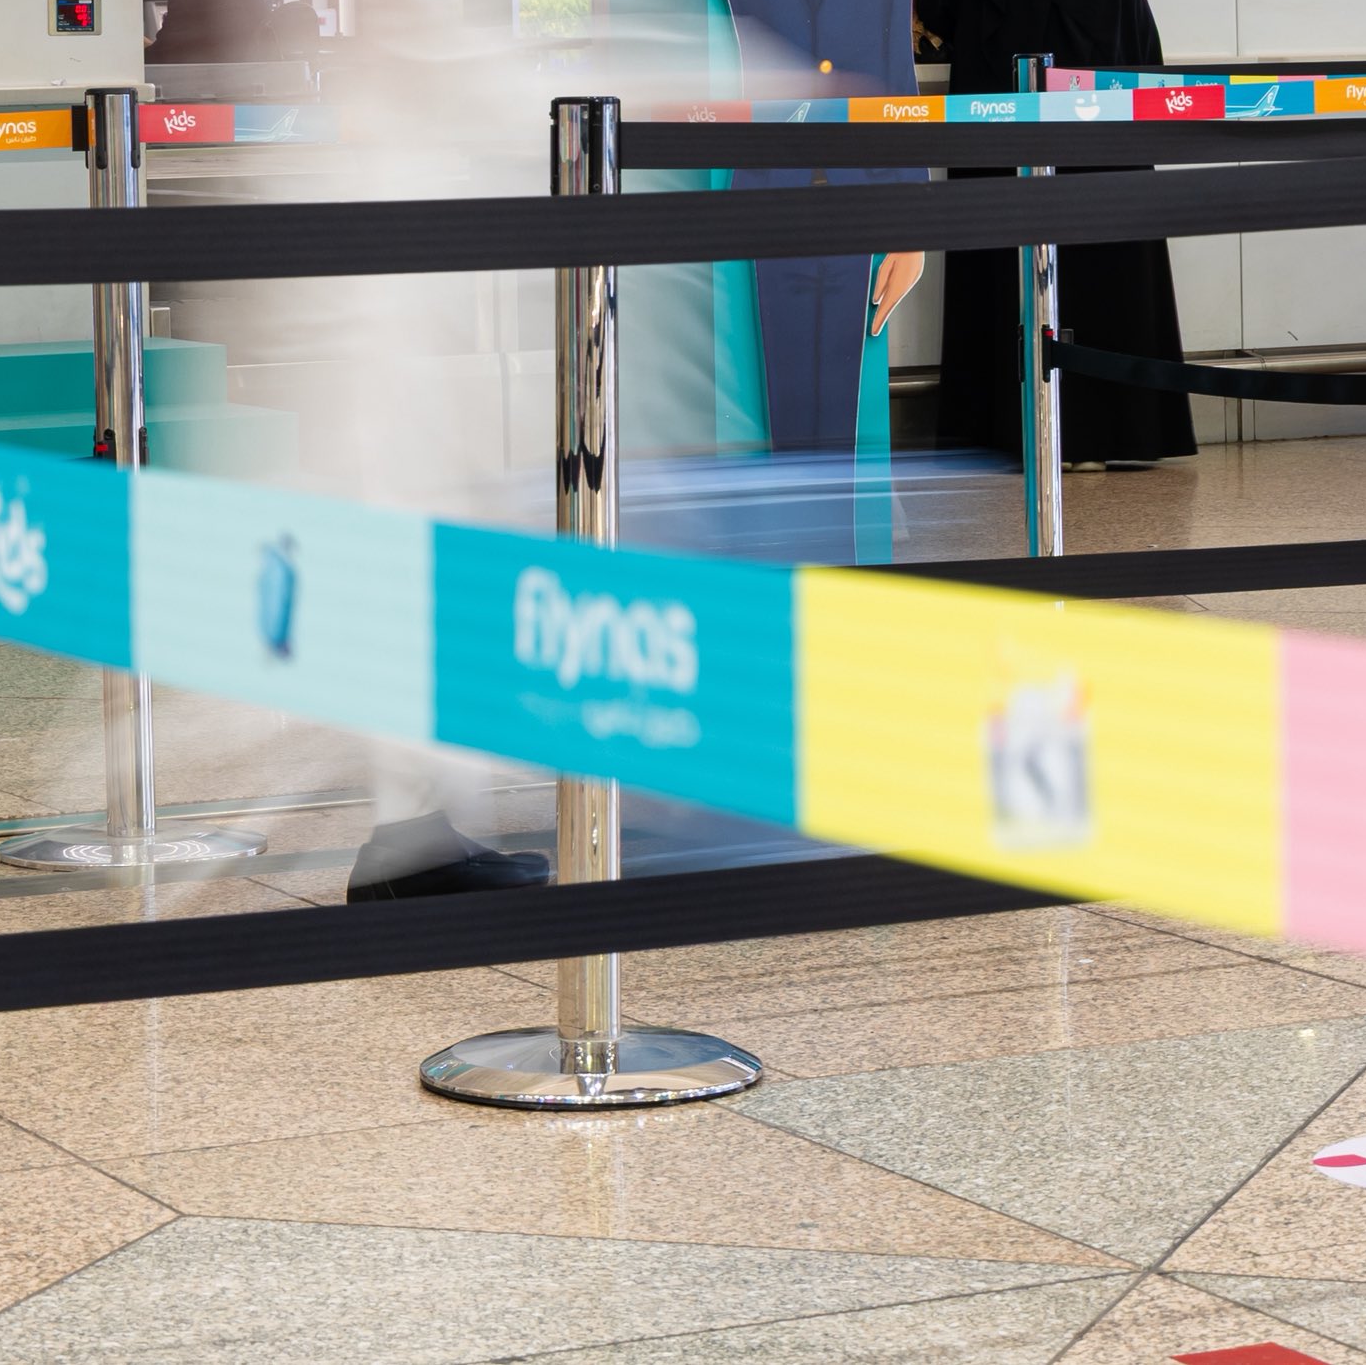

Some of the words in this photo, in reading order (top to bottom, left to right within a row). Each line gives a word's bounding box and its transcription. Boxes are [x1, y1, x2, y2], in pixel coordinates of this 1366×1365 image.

[883, 103, 929, 120] flynas
[970, 101, 1016, 118] flynas
[1165, 90, 1193, 113] kids
[164, 109, 196, 134] kids
[512, 566, 699, 693] flynas
